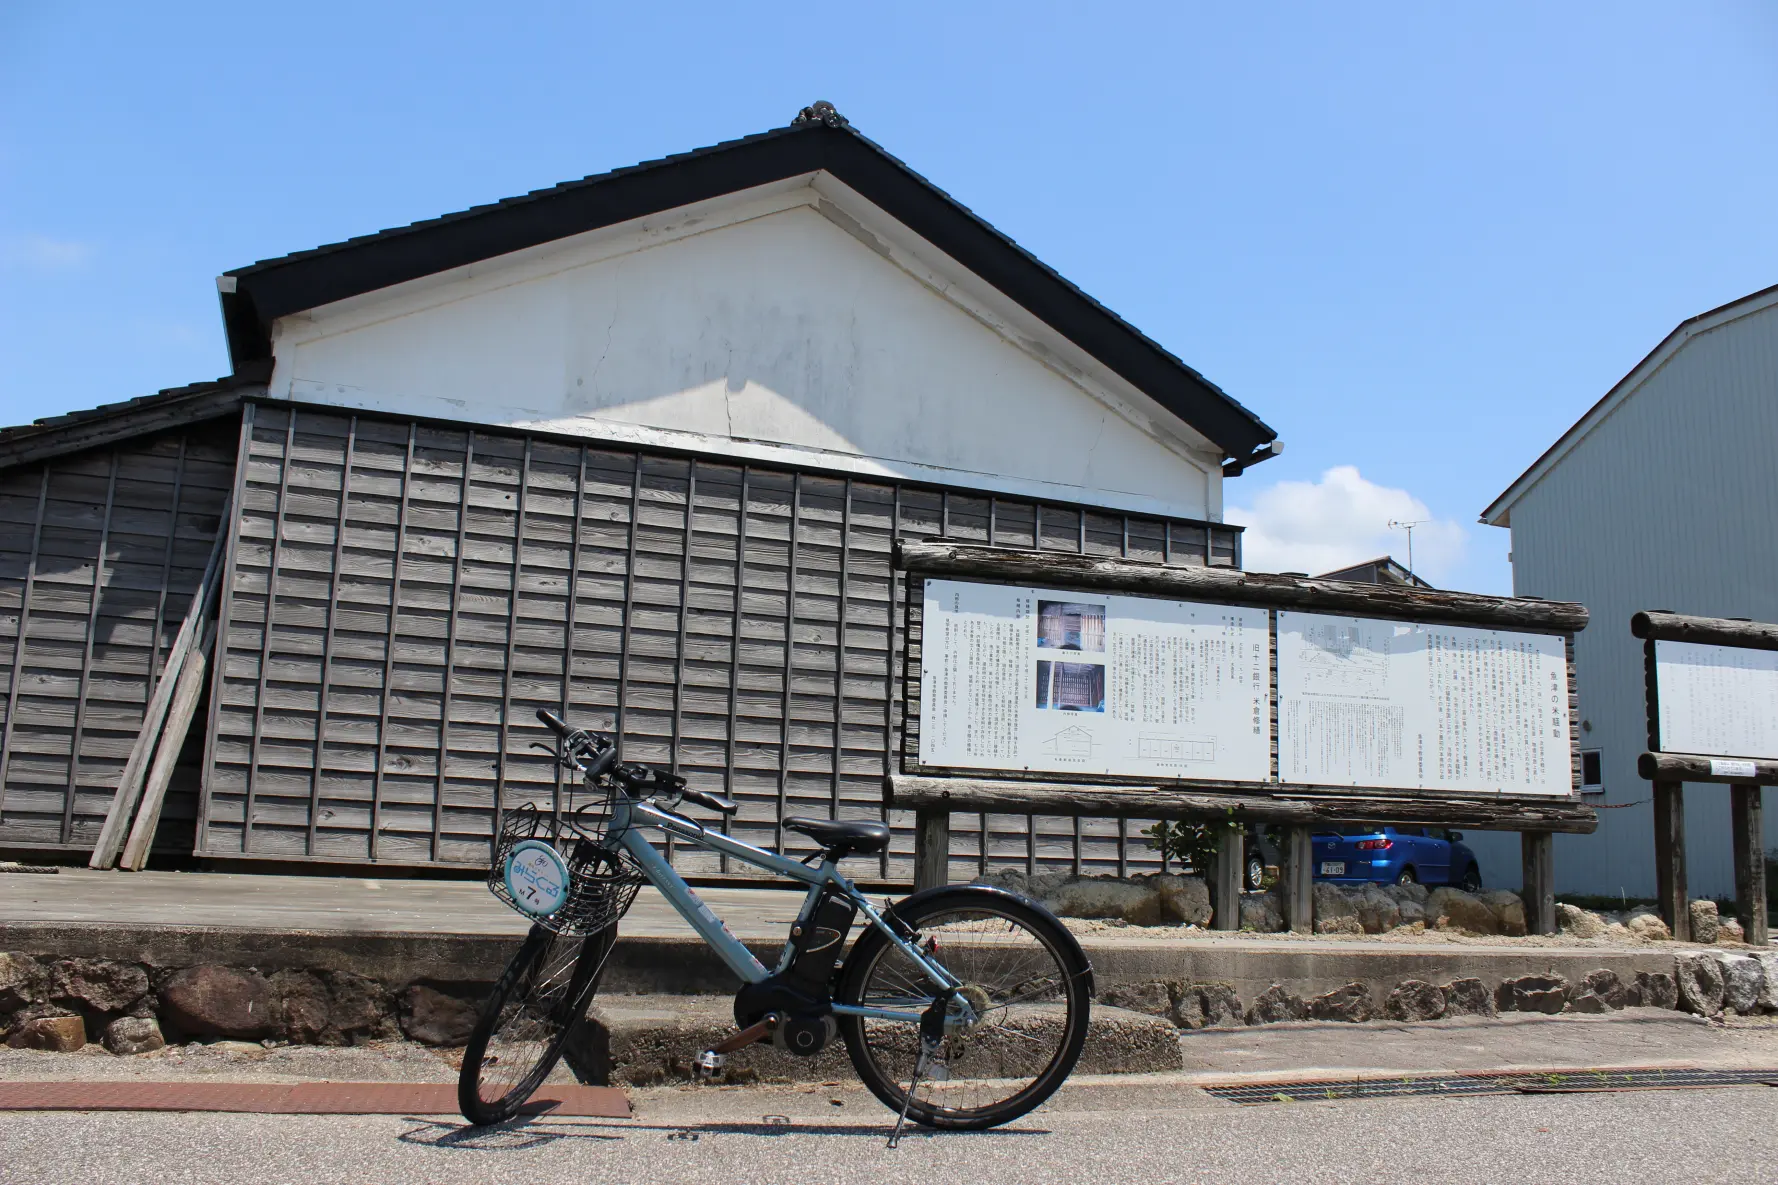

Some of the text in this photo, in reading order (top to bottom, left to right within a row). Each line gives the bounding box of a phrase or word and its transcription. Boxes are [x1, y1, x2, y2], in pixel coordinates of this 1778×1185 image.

[1550, 671, 1560, 738] 魚津の米騒動
